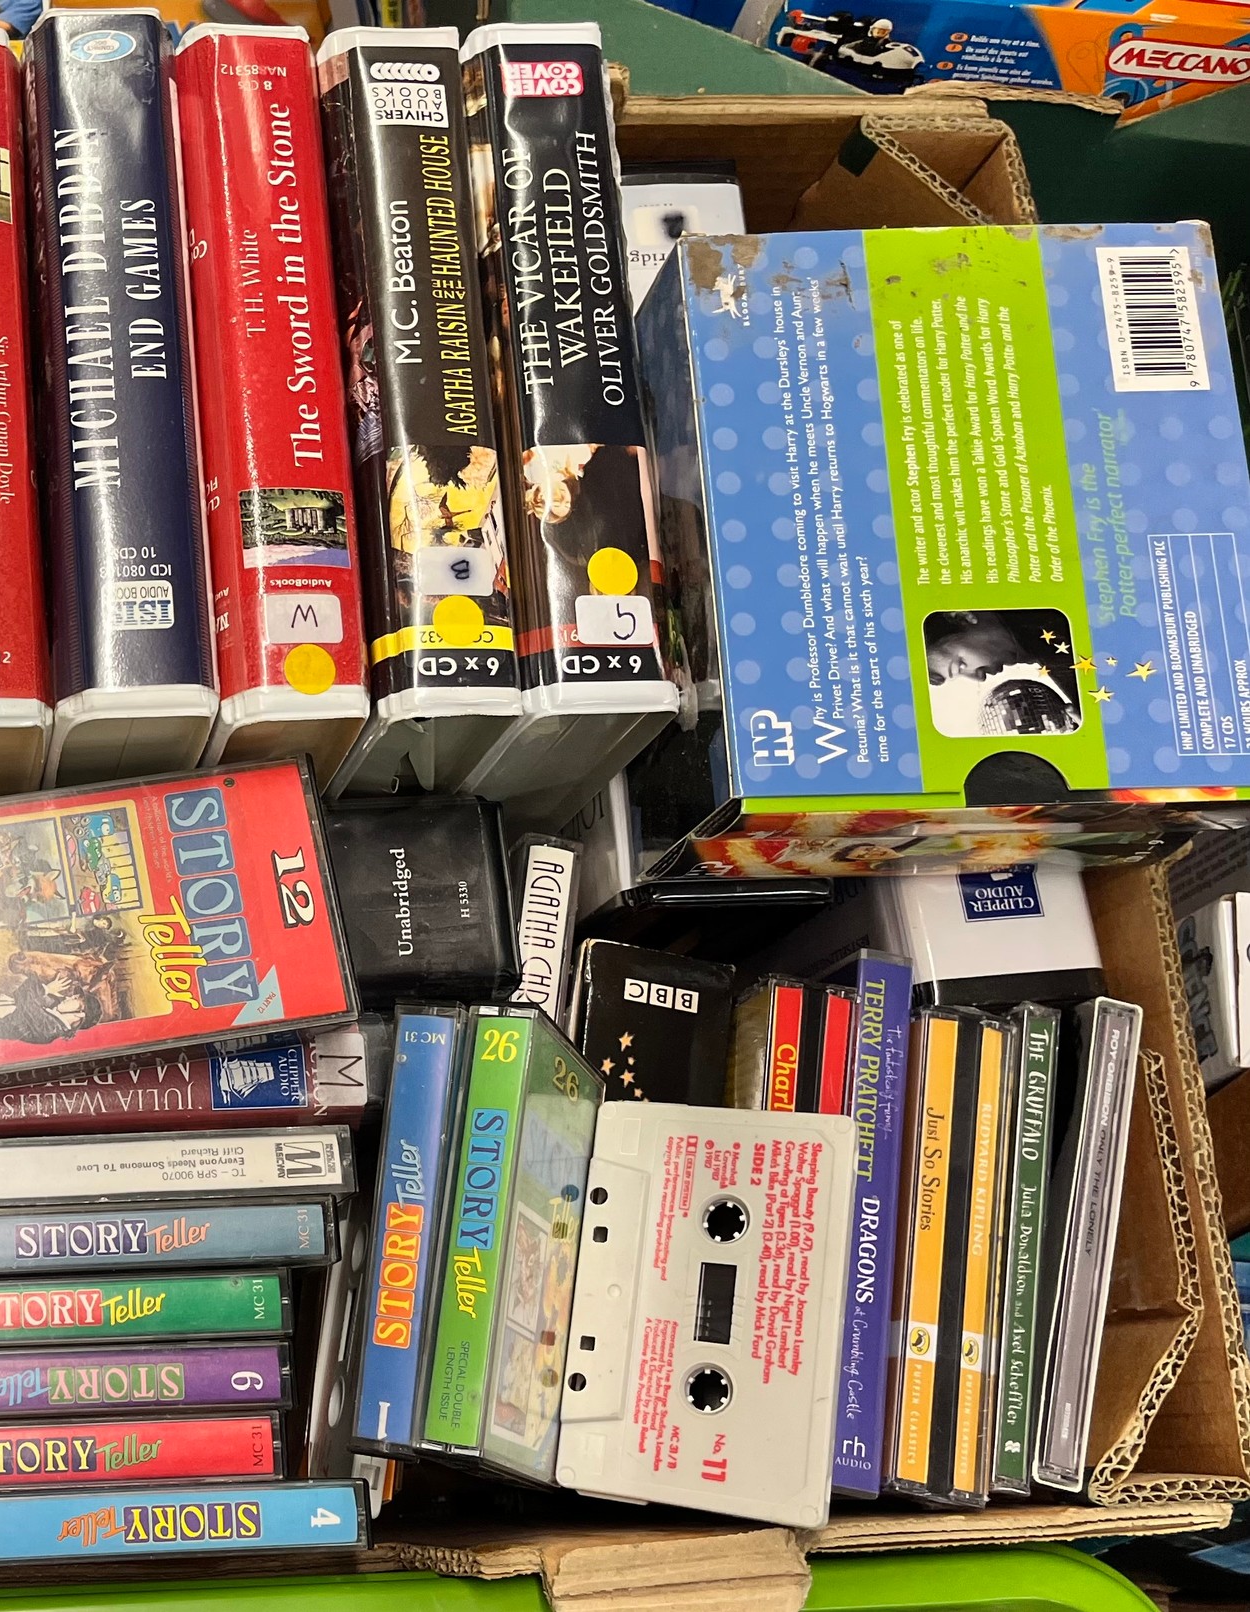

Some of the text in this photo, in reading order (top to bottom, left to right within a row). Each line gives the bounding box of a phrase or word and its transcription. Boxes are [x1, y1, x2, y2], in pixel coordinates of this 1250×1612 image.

[372, 87, 444, 100] BOOKS
[1113, 46, 1250, 76] MECCANO
[375, 110, 445, 123] CHIVERS
[239, 229, 264, 288] White
[419, 133, 461, 276] HAUNTED HOUSE
[54, 128, 121, 491] MICHAEL DIBDIN
[120, 199, 167, 379] END GAMES
[267, 103, 324, 467] The Sword in the Stone
[388, 200, 423, 365] M.C. Beaton
[502, 148, 554, 395] THE VICAR OF
[543, 167, 589, 369] WAKEFIELD
[574, 131, 625, 406] OLIVER GOLDSMITH
[435, 302, 478, 437] AGATHA RAISIN
[270, 577, 332, 588] AudioBooks
[799, 554, 823, 689] Professor Dumbledore
[1156, 557, 1183, 671] BLOOMSBURY PUBLISHING
[1184, 610, 1215, 750] COMPLETE UNABRIDGED
[167, 791, 257, 1004] STORY
[272, 846, 316, 930] 12
[389, 847, 414, 957] Unabridged
[522, 859, 566, 950] AGATHA
[970, 896, 1036, 913] CLIPPER
[974, 884, 1025, 899] AUDIO
[138, 894, 208, 1010] Teller
[626, 980, 698, 1012] BBC
[853, 978, 887, 1182] TERRY PRATCHETT
[1021, 1028, 1049, 1161] THE GRUFFALO
[118, 1156, 246, 1172] Everyone Someone
[453, 1029, 520, 1319] 26 STORY Teller
[752, 1143, 766, 1175] SIDE
[919, 1105, 946, 1232] Just Stories
[972, 1102, 993, 1257] RUDYARD KIPLING
[16, 1216, 211, 1258] STORY Teller
[375, 1138, 426, 1346] STORY Teller
[854, 1196, 881, 1305] DRAGONS
[1085, 1202, 1098, 1256] LONELY
[99, 1287, 166, 1326] Teller
[1004, 1223, 1034, 1425] Donaldson Scheffler
[50, 1365, 182, 1402] STORY
[94, 1433, 162, 1473] Teller
[701, 1458, 728, 1483] 11
[835, 1456, 872, 1470] AUDIO
[57, 1503, 260, 1547] STORY Teller
[310, 1507, 342, 1528] 4
